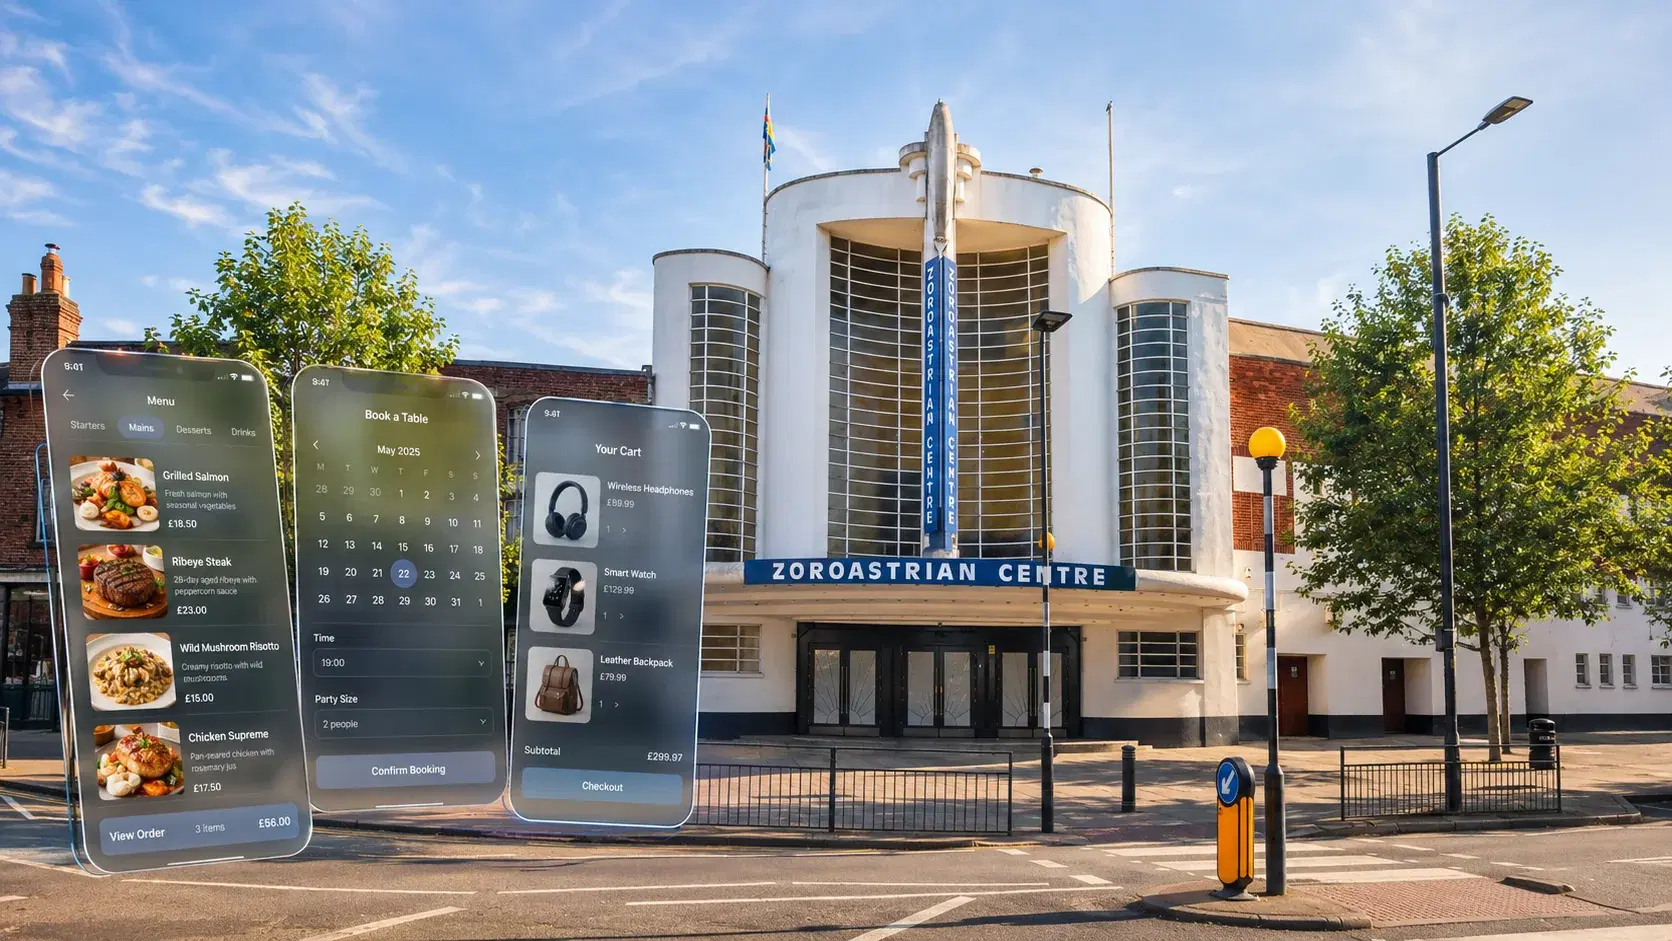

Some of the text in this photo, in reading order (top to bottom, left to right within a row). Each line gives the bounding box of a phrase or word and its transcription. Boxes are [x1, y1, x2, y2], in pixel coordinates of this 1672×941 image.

[948, 267, 956, 426] ZOROASTRIAN
[147, 395, 175, 406] Menu
[926, 267, 934, 524] ZOROASTRIAN CENTRE
[365, 409, 429, 424] Book a Table
[70, 420, 256, 438] Starters Mains Desserts Drinks
[377, 445, 421, 457] May 2025
[595, 444, 642, 458] Your Cart
[163, 470, 230, 483] Grilled Salmon
[316, 485, 479, 502] 28 29 30 1 2 3 4
[608, 481, 694, 496] Wireless Headphones
[168, 519, 198, 528] £18.50
[319, 512, 481, 528] 5 6 7 8 9 10 11
[606, 525, 610, 533] 1
[319, 539, 483, 555] 12 13 14 15 16 17 18
[172, 556, 232, 569] Ribeye Steak
[319, 567, 485, 581] 19 20 21 22 23 24 25
[604, 568, 656, 579] Smart Watch
[772, 561, 1105, 586] ZOROASTRIAN CENTRE
[174, 588, 216, 596] peppercorn
[319, 594, 483, 607] 26 27 28 29 30 31 1
[176, 606, 207, 615] £23.00
[602, 612, 607, 620] 1
[314, 634, 335, 642] Time
[180, 641, 280, 653] Wild Mushroom Risotto
[182, 662, 209, 672] Creamy
[210, 662, 233, 670] risotto
[321, 658, 345, 667] 19:00
[600, 655, 674, 668] Leather Backpack
[600, 672, 626, 682] £79.99
[184, 693, 214, 703] £15.00
[315, 694, 358, 704] Party Size
[599, 700, 603, 708] 1
[322, 720, 358, 730] 2 people
[188, 730, 269, 743] Chicken Supreme
[524, 746, 683, 762] Subtotal £299.97
[371, 765, 446, 776] Confirm Booking
[193, 782, 222, 793] £17.50
[582, 782, 624, 792] Checkout
[109, 828, 166, 842] View Order
[195, 824, 226, 834] 3 items
